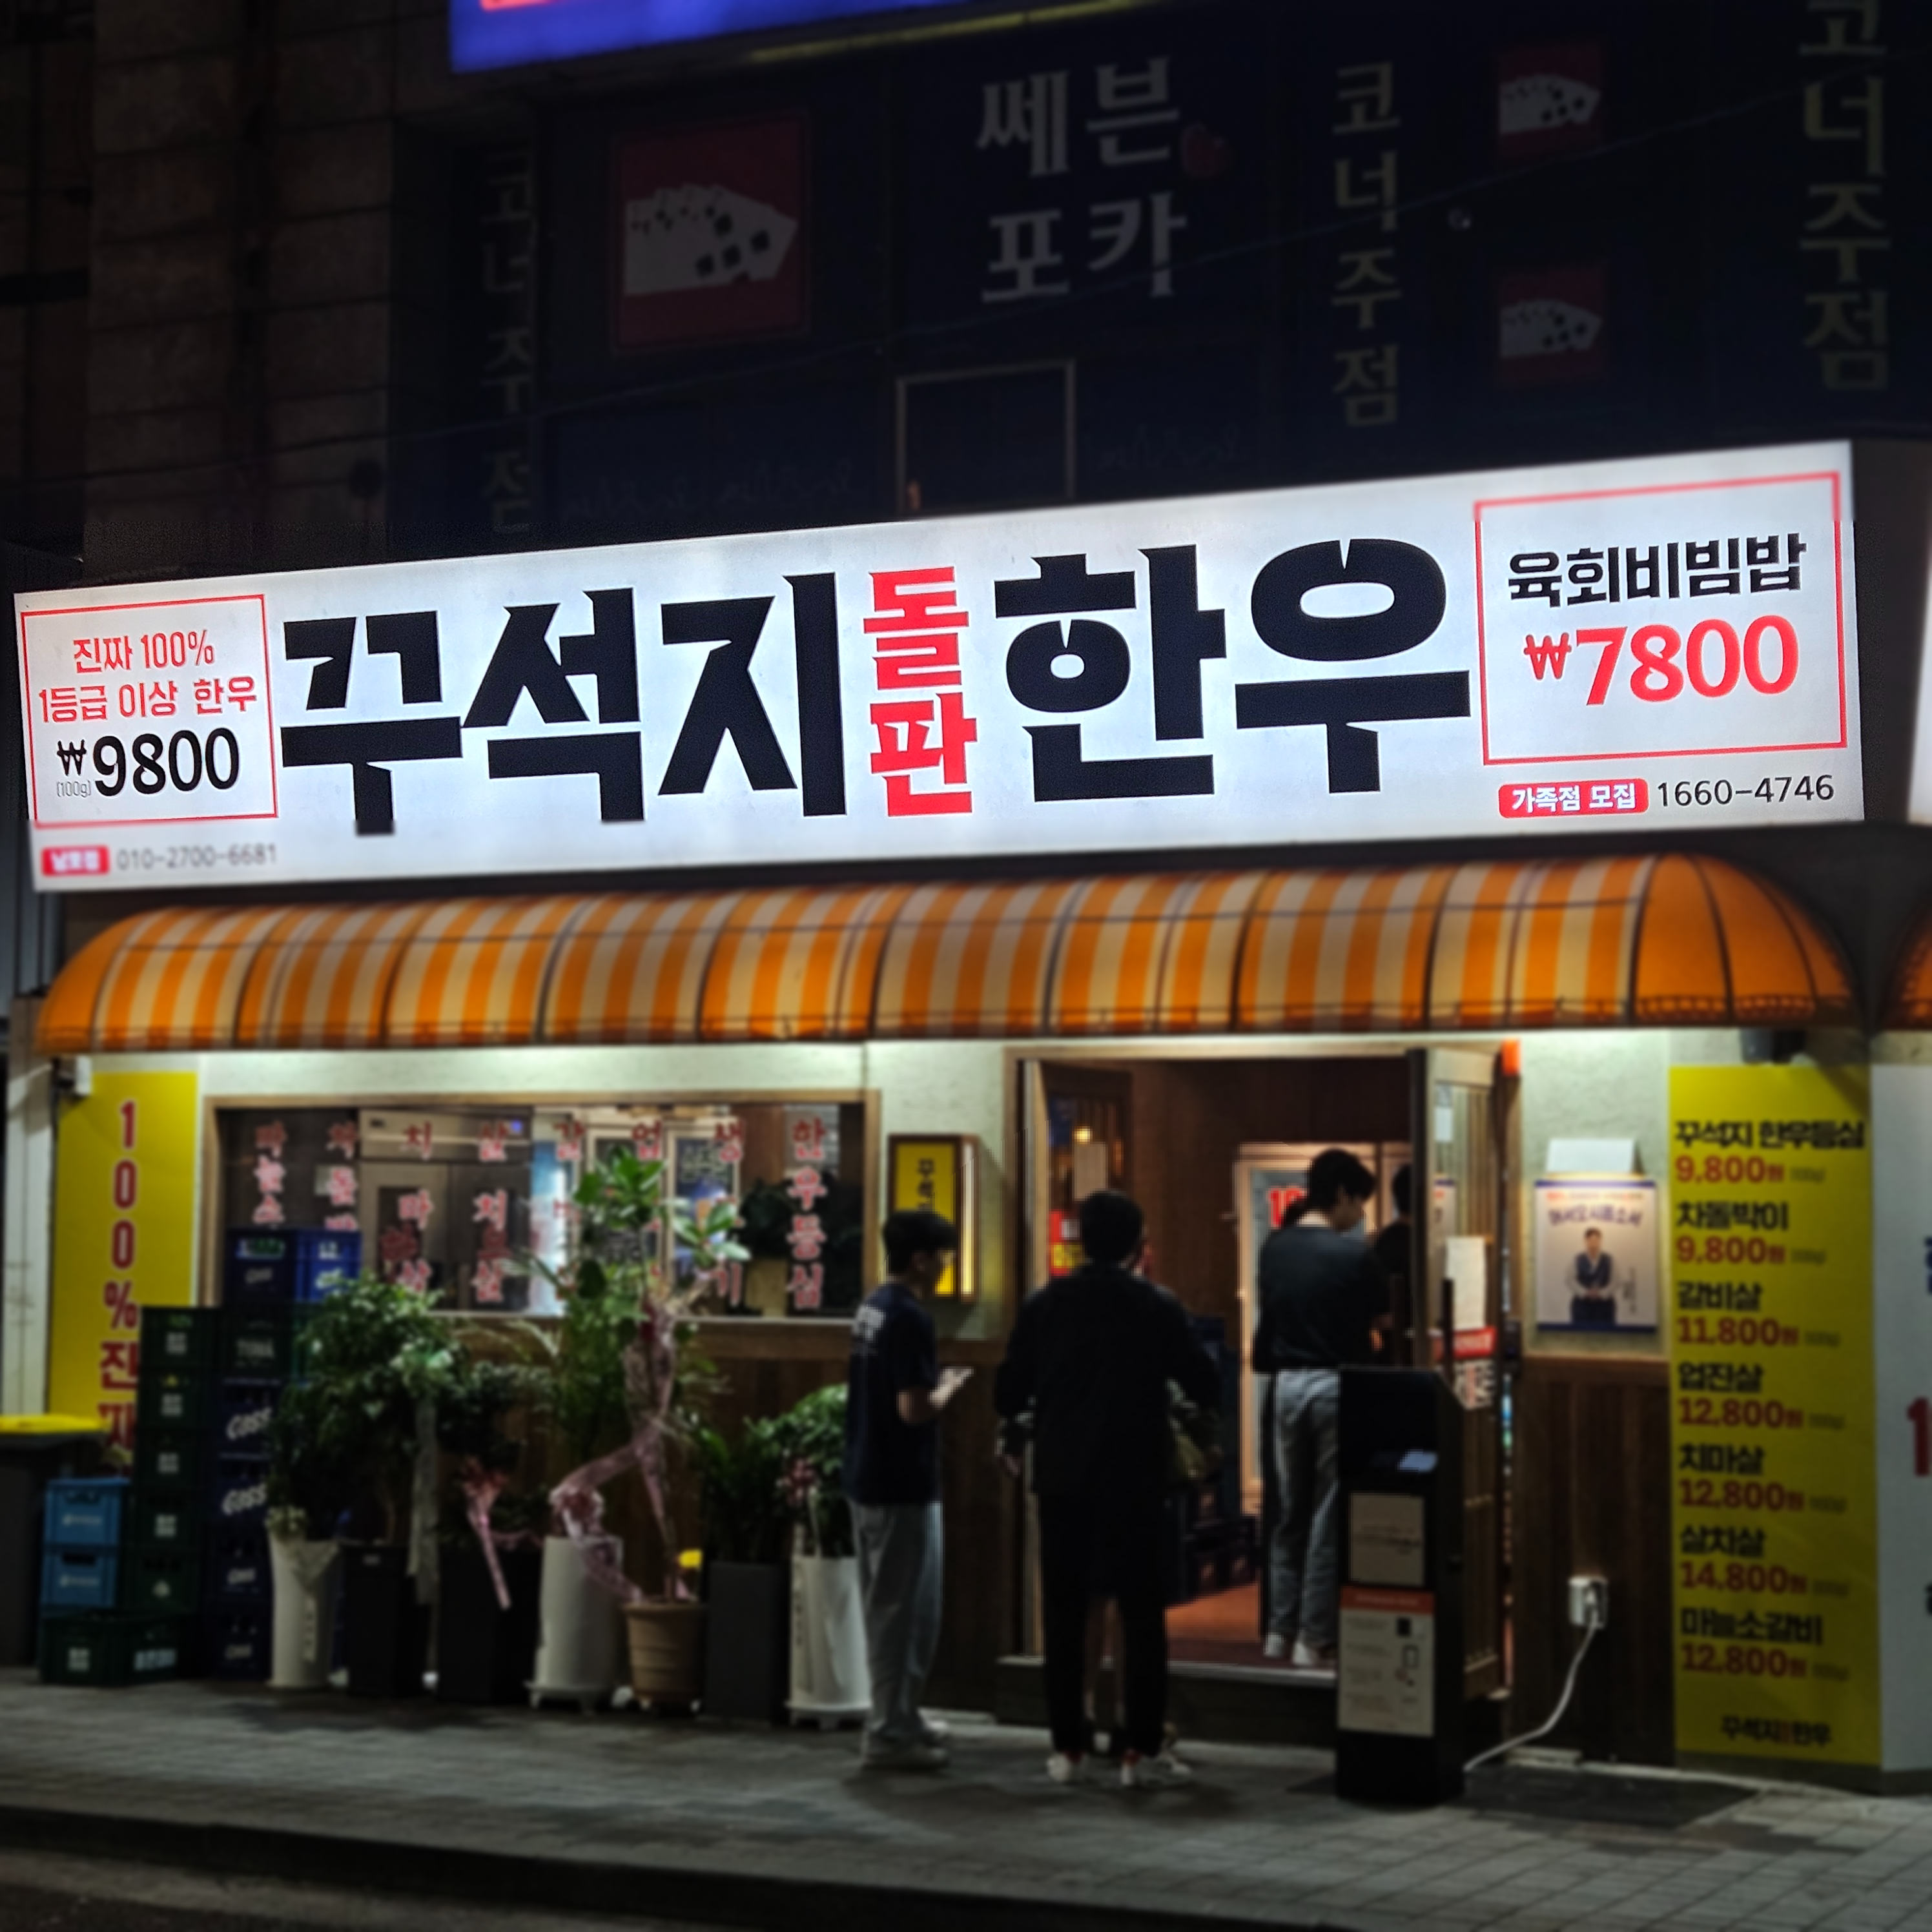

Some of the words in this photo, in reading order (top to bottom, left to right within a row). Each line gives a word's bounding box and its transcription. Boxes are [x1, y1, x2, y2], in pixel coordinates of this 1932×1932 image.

[976, 56, 1180, 178] 쎄븐
[981, 191, 1187, 303] 포카
[1331, 61, 1402, 427] 코너주점
[1508, 533, 1807, 608] 육회비빔밥
[39, 685, 108, 723] 1등급
[119, 681, 179, 718] 이상
[193, 676, 257, 715] 한우
[73, 635, 133, 674] 진짜
[140, 629, 216, 669] 100%
[280, 572, 847, 836] 꾸석지
[863, 566, 977, 817] 돌판
[994, 538, 1471, 802] 한우
[1524, 615, 1799, 706] ₩7800
[1512, 785, 1582, 814] 가족점
[1589, 783, 1636, 810] 모집
[1658, 775, 1834, 807] 1660-4746
[786, 1117, 828, 1310] 한우등심
